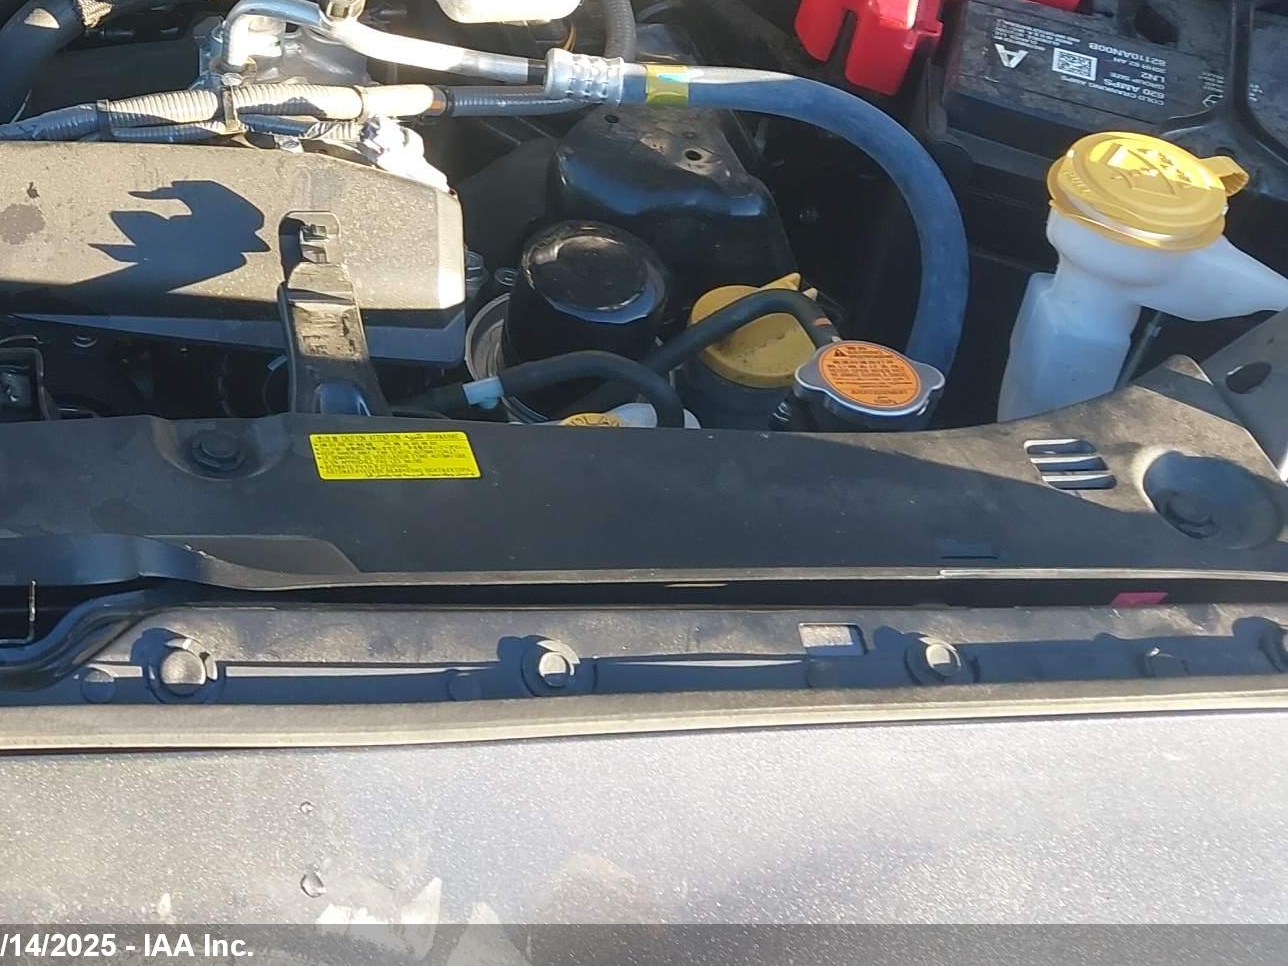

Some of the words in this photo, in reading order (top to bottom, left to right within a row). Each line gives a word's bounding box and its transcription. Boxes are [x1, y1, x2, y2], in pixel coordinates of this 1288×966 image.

[994, 43, 1029, 69] A
[1088, 42, 1167, 66] 82110AN00B
[1060, 75, 1087, 86] AMPS
[1141, 72, 1165, 83] LN2
[1088, 81, 1138, 100] CRANKING
[1103, 78, 1142, 93] AMPS
[1138, 94, 1165, 106] COLD
